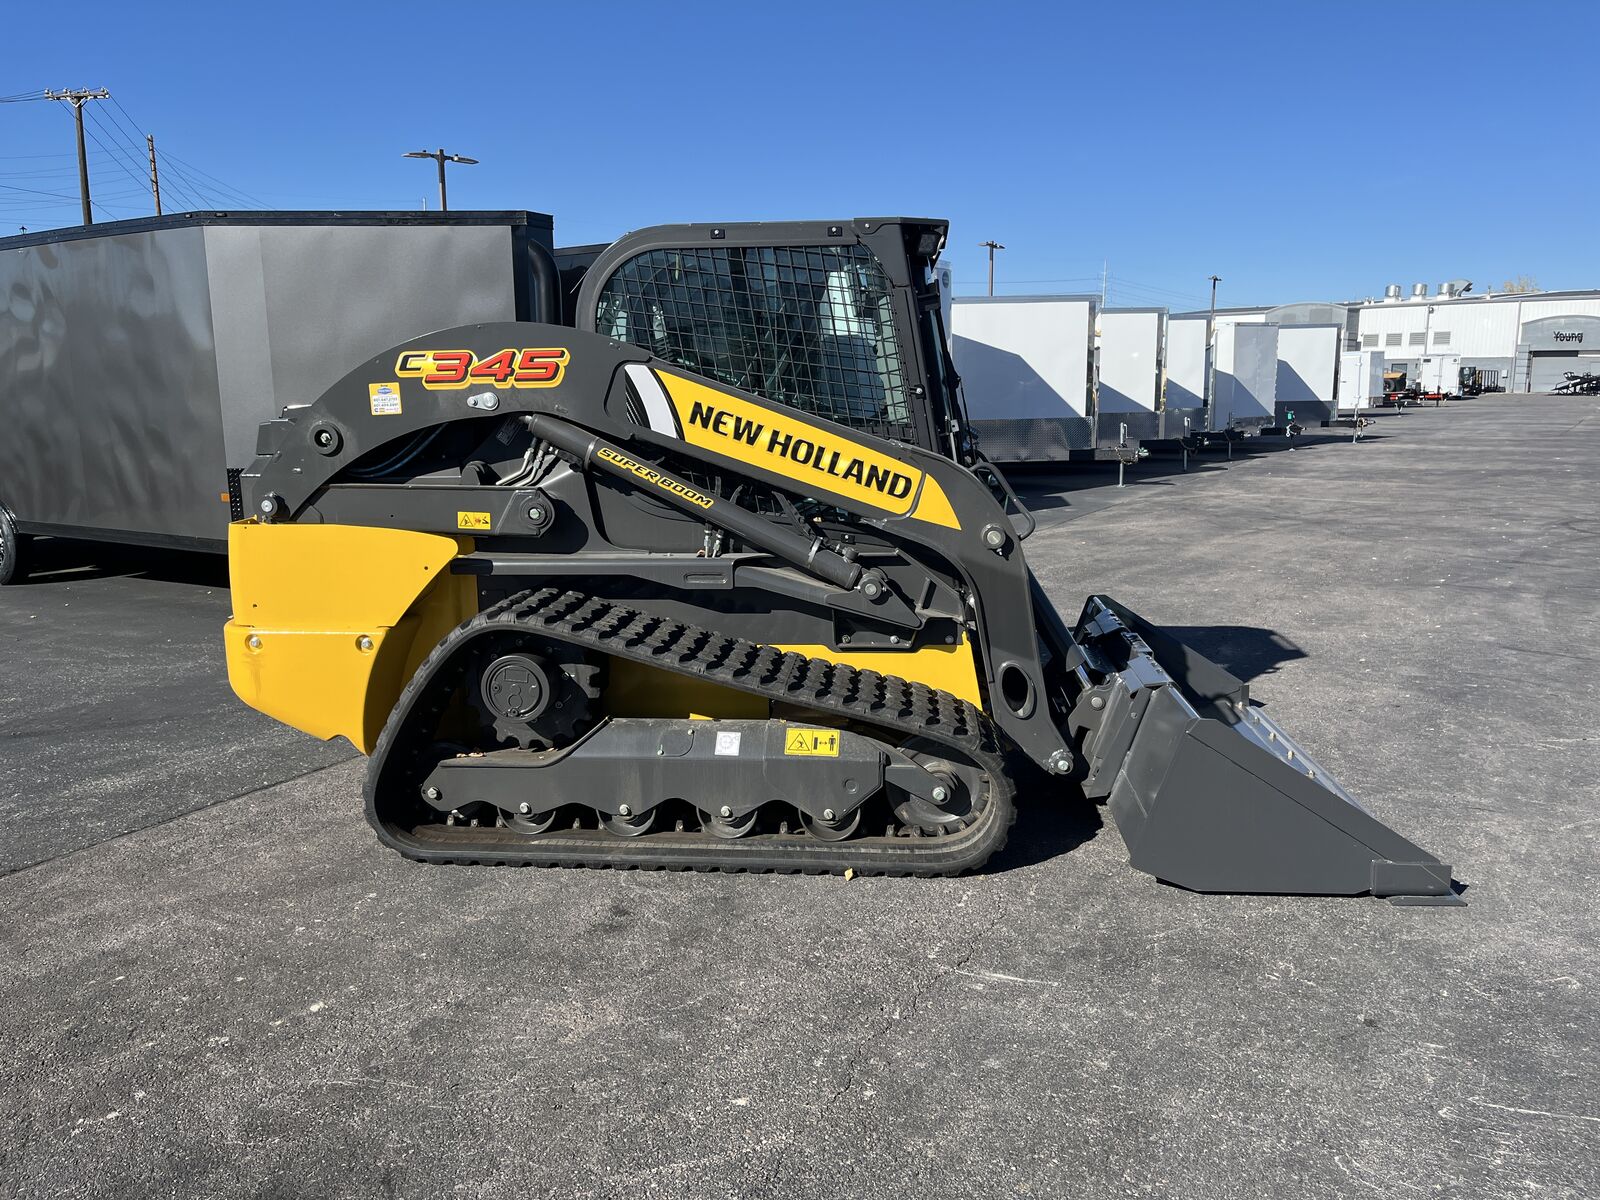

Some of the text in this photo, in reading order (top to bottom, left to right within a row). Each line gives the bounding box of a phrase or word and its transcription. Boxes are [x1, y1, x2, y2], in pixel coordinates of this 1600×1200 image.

[1553, 331, 1583, 343] Young
[397, 349, 568, 386] C345
[689, 401, 912, 499] NEW HOLLAND
[599, 448, 713, 508] SUPER BOOM
